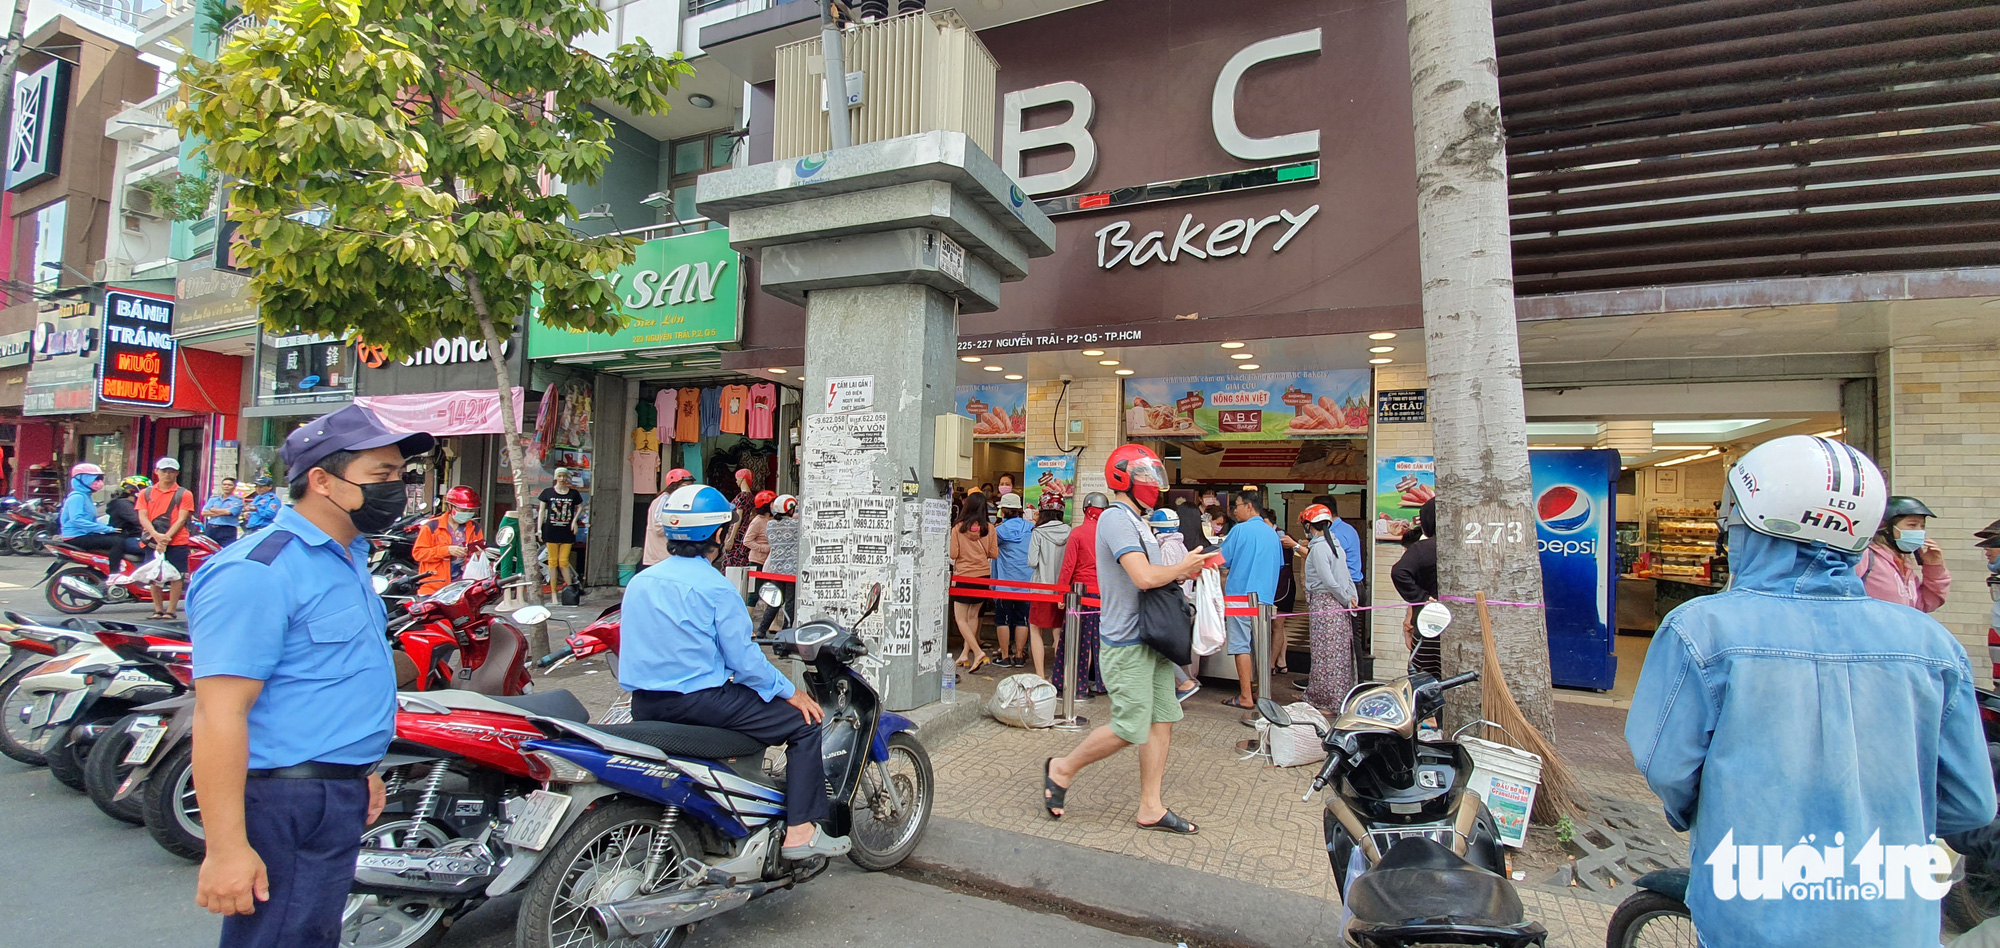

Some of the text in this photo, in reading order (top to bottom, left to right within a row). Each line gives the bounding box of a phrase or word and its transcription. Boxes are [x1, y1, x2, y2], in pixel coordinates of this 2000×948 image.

[1095, 205, 1320, 269] Bakery
[625, 260, 728, 309] SAN
[116, 299, 170, 323] BÁNH
[108, 326, 172, 350] TRÁNG
[996, 333, 1033, 348] NGUYỄN
[1105, 330, 1142, 341] TP.HCM
[118, 352, 160, 374] MUỐI
[104, 376, 171, 402] NHUYỄN
[1213, 392, 1268, 404] NÔNG SẢN VIỆT
[1391, 401, 1423, 410] CHÂU
[867, 422, 885, 431] VỐN
[1425, 462, 1434, 471] VIỆ
[1829, 498, 1856, 510] LED
[853, 518, 892, 529] 0989.21.85.21
[1465, 521, 1523, 544] 273
[1537, 538, 1596, 557] pepsi
[895, 641, 909, 654] PHÍ
